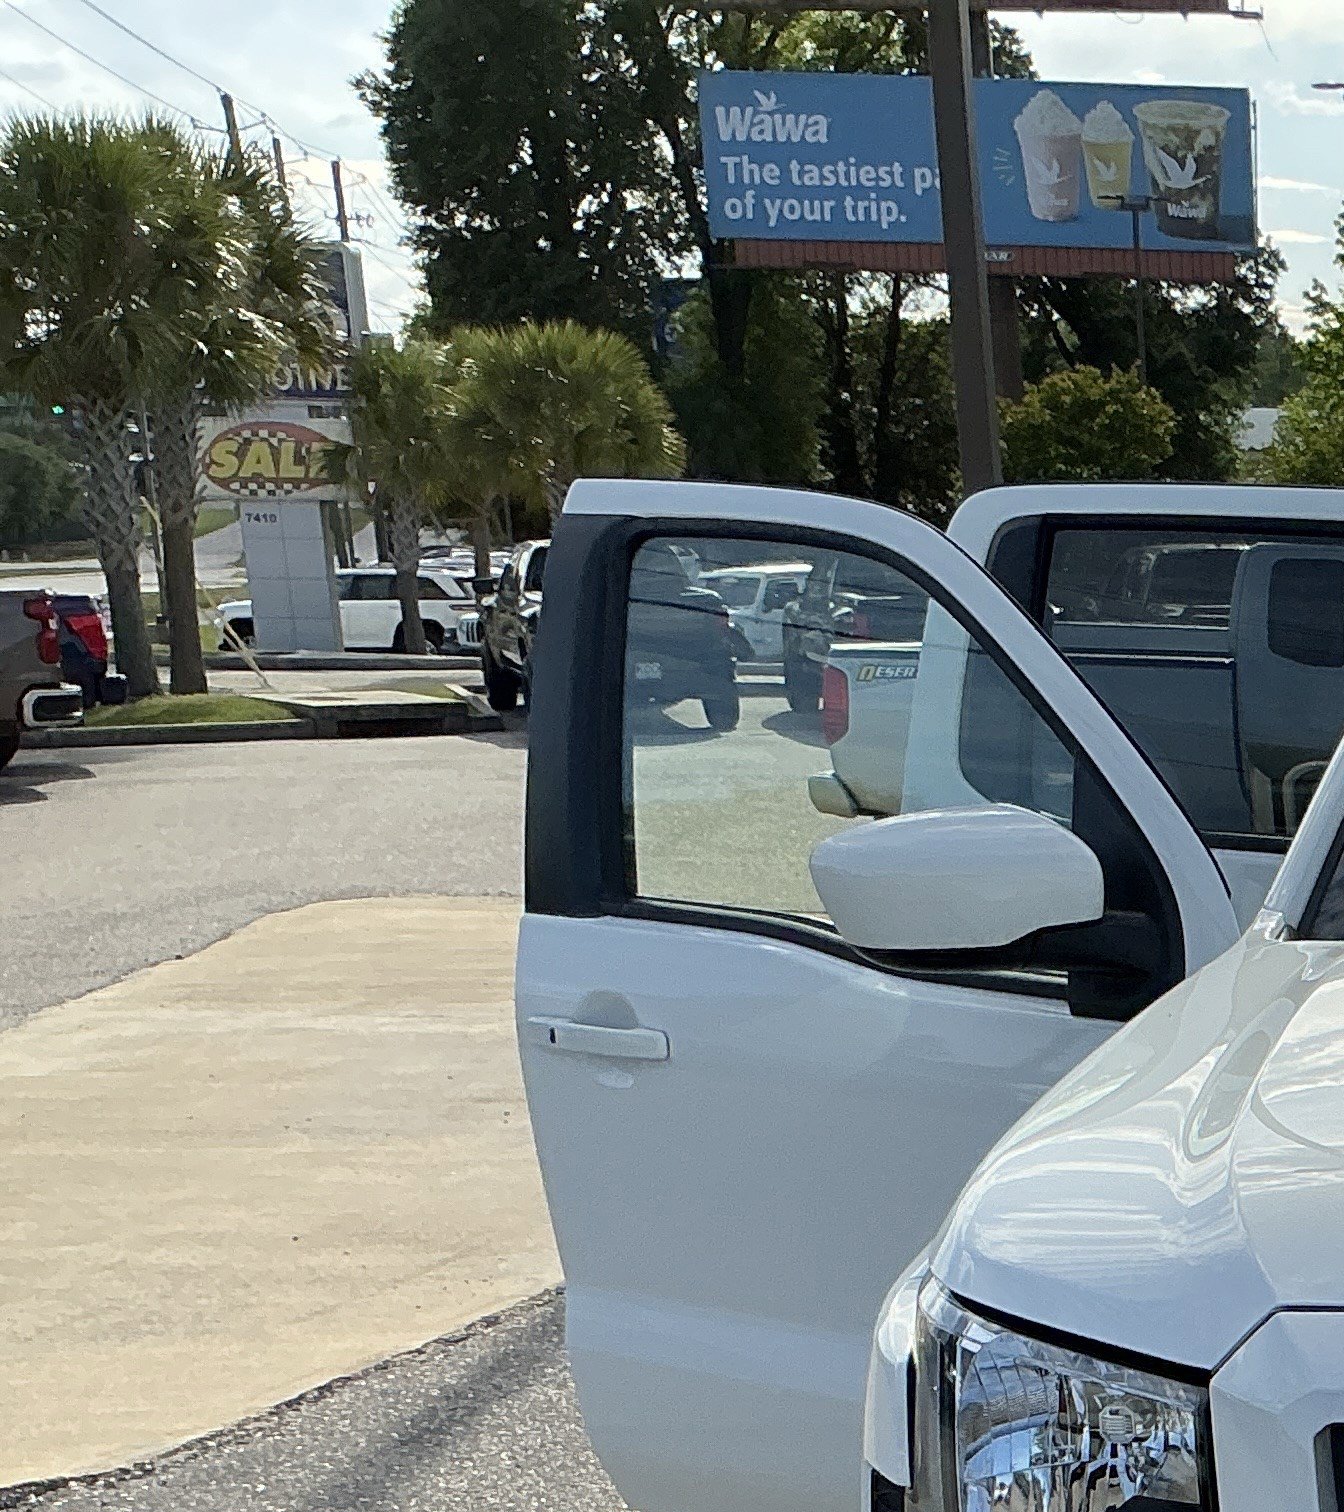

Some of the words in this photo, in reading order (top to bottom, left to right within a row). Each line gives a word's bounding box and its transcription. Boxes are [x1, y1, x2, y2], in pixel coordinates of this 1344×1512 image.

[715, 105, 829, 144] Wawa
[719, 154, 781, 185] The
[789, 157, 905, 188] tastiest
[724, 190, 755, 220] of
[763, 199, 836, 228] your
[845, 193, 907, 230] trip.
[245, 512, 278, 523] 7410
